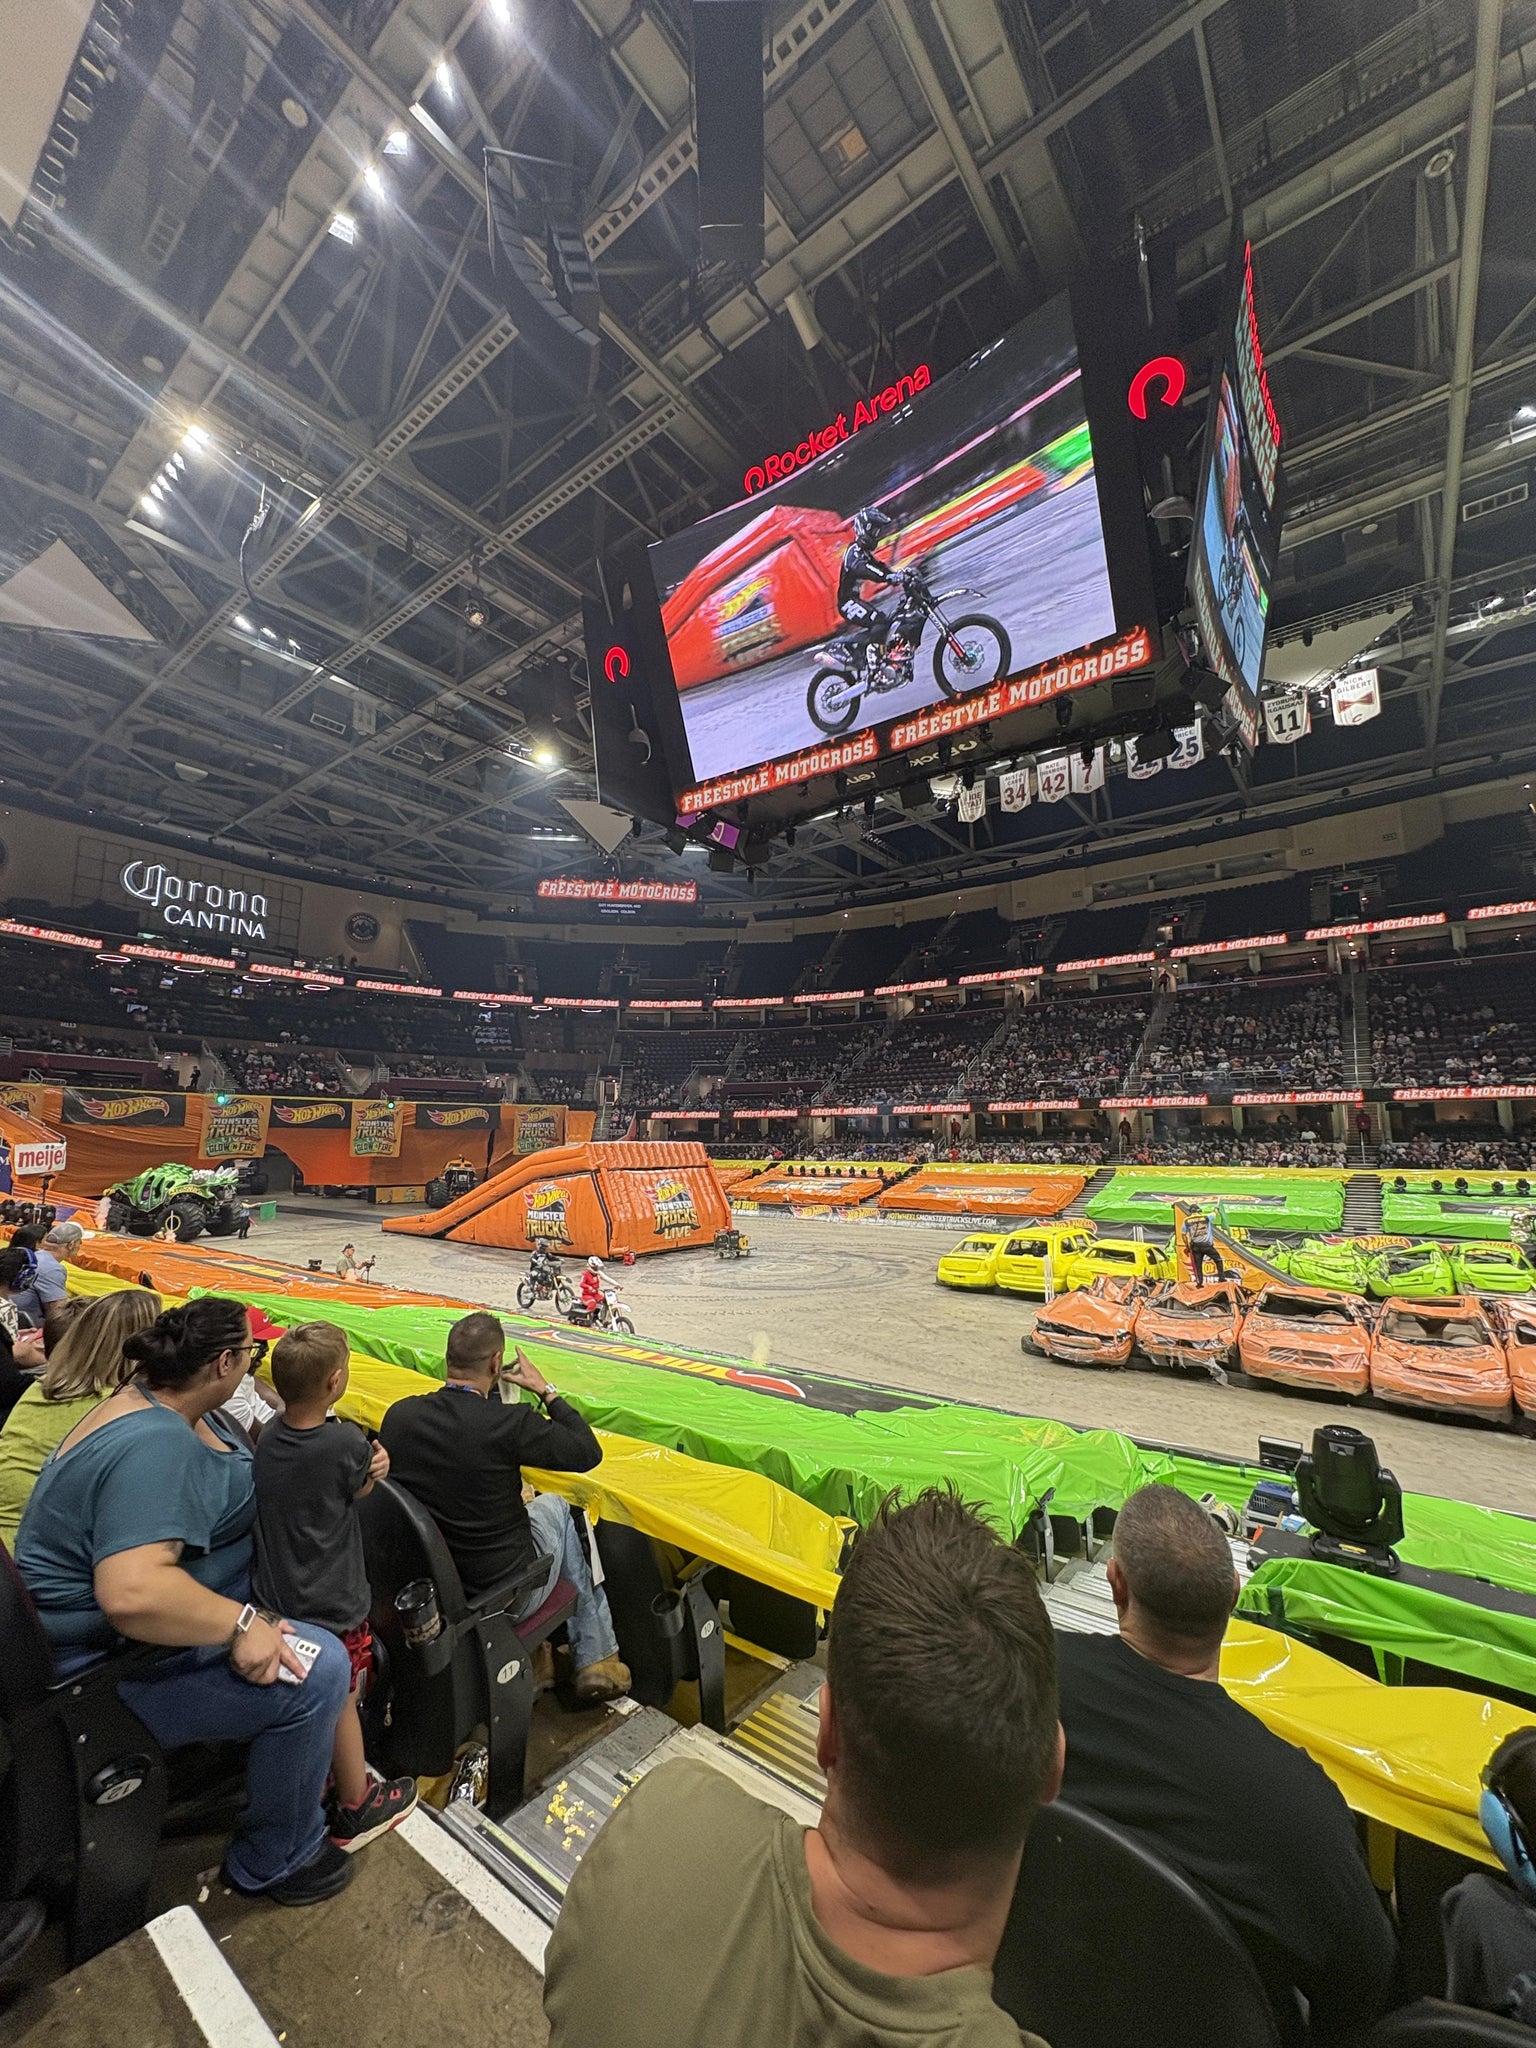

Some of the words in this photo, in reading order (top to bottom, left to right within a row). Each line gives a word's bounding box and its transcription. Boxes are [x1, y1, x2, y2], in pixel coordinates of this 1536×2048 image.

[764, 412, 849, 484] Rocket
[853, 364, 931, 433] Arena
[1336, 680, 1372, 694] GILBERT
[1343, 675, 1365, 686] NICK
[894, 693, 1000, 747] FREESTYLE
[1009, 639, 1145, 705] MOTOCROSS
[1267, 692, 1304, 708] ZYDRUNA
[1274, 709, 1301, 735] 11
[1171, 736, 1199, 760] 25
[683, 771, 769, 811] FREESTYLE
[775, 739, 874, 783] MOTOCROSS
[1005, 772, 1025, 782] AUSTIN
[1082, 764, 1092, 784] 7
[1042, 773, 1065, 794] 42
[1004, 784, 1026, 805] 34
[120, 861, 269, 917] Corona
[540, 881, 613, 897] FREESTYLE
[618, 884, 695, 901] MOTOCROSS
[1468, 901, 1536, 919] FREESTYL
[164, 904, 266, 939] CANTINA
[1306, 924, 1369, 940] FREESTYLE
[1373, 914, 1445, 930] MOTOCROSS
[0, 922, 36, 936] STYLE
[39, 930, 102, 948] MOTOCROSS
[1171, 944, 1223, 957] FREESTYLE
[1226, 935, 1287, 951] MOTOCROSS
[121, 944, 178, 959] FREESTYLE
[181, 953, 236, 969] MOTOCROSS
[1056, 960, 1101, 972] FREESTYLE
[1104, 952, 1155, 965] MOTOCROSS
[250, 964, 297, 977] FREESTYLE
[300, 971, 344, 985] MOTOCROSS
[1233, 1093, 1291, 1104] FREESTYLE
[1296, 1090, 1363, 1102] MOTOCROSS
[1394, 1088, 1465, 1100] FREESTYLE
[1471, 1086, 1536, 1097] MOTOCRO
[104, 1102, 128, 1118] HOT
[128, 1097, 165, 1114] WHEELS
[988, 1101, 1030, 1111] FREESTYLE
[1032, 1099, 1079, 1110] MOTOCROSS
[1100, 1097, 1149, 1108] FREESTYLE
[1152, 1095, 1208, 1107] MOTOCROSS
[222, 1106, 238, 1117] HOT
[293, 1109, 313, 1122] HOT
[311, 1105, 342, 1119] WHEELS
[444, 1113, 461, 1124] HOT
[459, 1110, 487, 1122] WHEELS
[213, 1117, 258, 1125] MONSTER
[209, 1124, 259, 1137] TRUCKS
[356, 1126, 395, 1137] TRUCKS
[519, 1128, 557, 1138] TRUCKS
[208, 1143, 230, 1153] GLOW
[239, 1143, 256, 1152] FIRE
[356, 1143, 374, 1151] GLOW
[533, 1193, 549, 1208] HOT
[655, 1201, 693, 1211] MONSTER
[527, 1211, 565, 1221] MONSTER
[656, 1210, 698, 1228] TRUCKS
[526, 1220, 568, 1236] TRUCKS
[664, 1226, 691, 1239] LIVE
[1373, 1236, 1406, 1248] WHEELS
[703, 1624, 713, 1635] 10
[502, 1664, 514, 1679] 11
